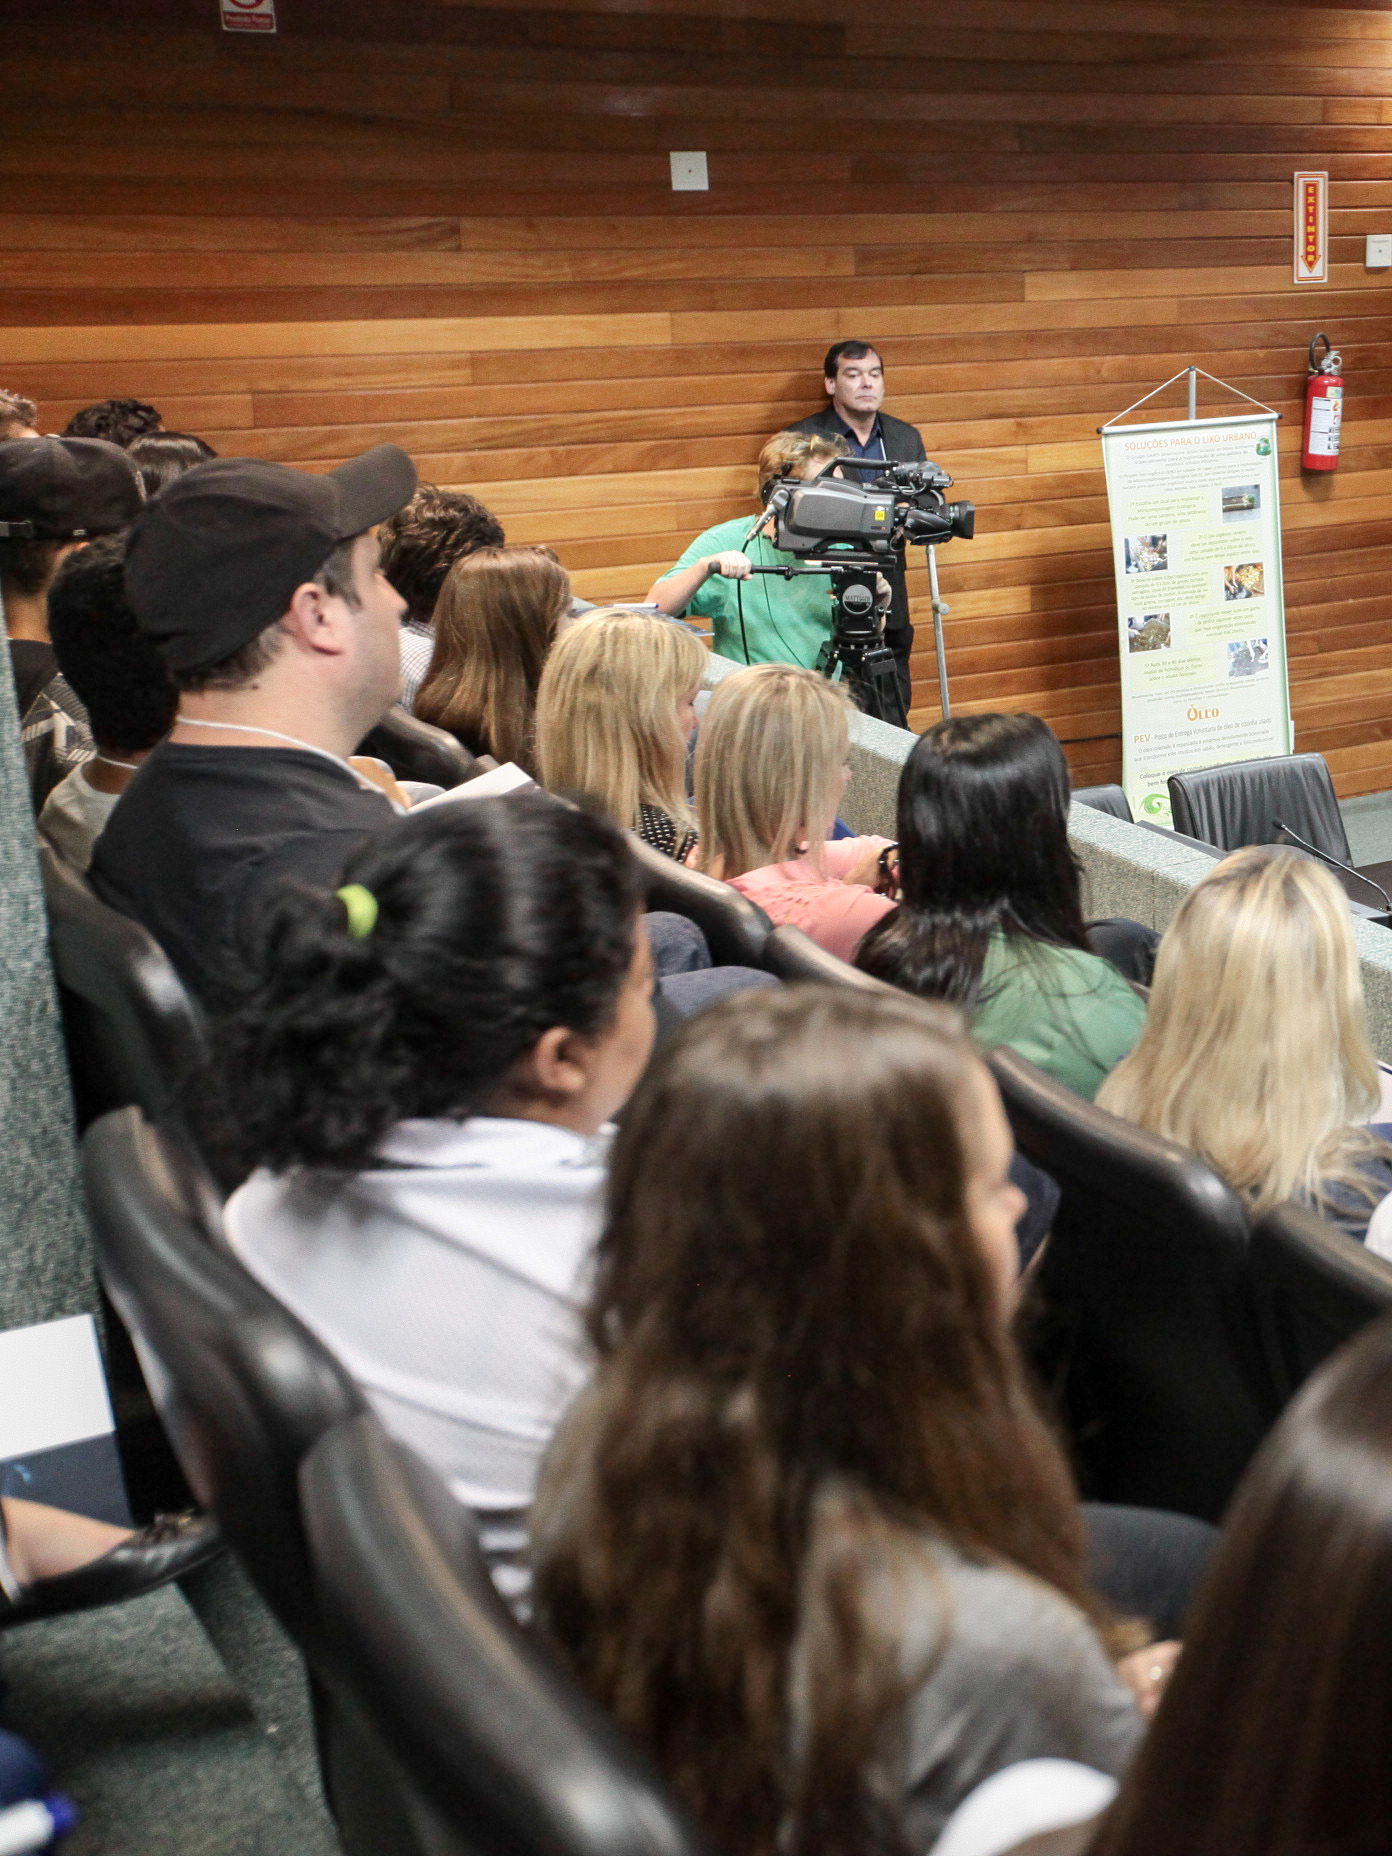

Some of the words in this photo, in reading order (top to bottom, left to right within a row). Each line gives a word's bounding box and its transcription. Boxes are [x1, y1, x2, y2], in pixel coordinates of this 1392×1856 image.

[1307, 186, 1315, 262] EXTINTOR
[1124, 439, 1168, 451] SOLUÇÕES
[1170, 437, 1192, 447] PARA
[1193, 436, 1200, 445] O
[1202, 434, 1221, 444] LIXO
[1222, 432, 1257, 442] URBANO
[1187, 704, 1220, 721] ÓLEO
[1134, 734, 1151, 744] PEV
[1139, 772, 1162, 780] Coloque
